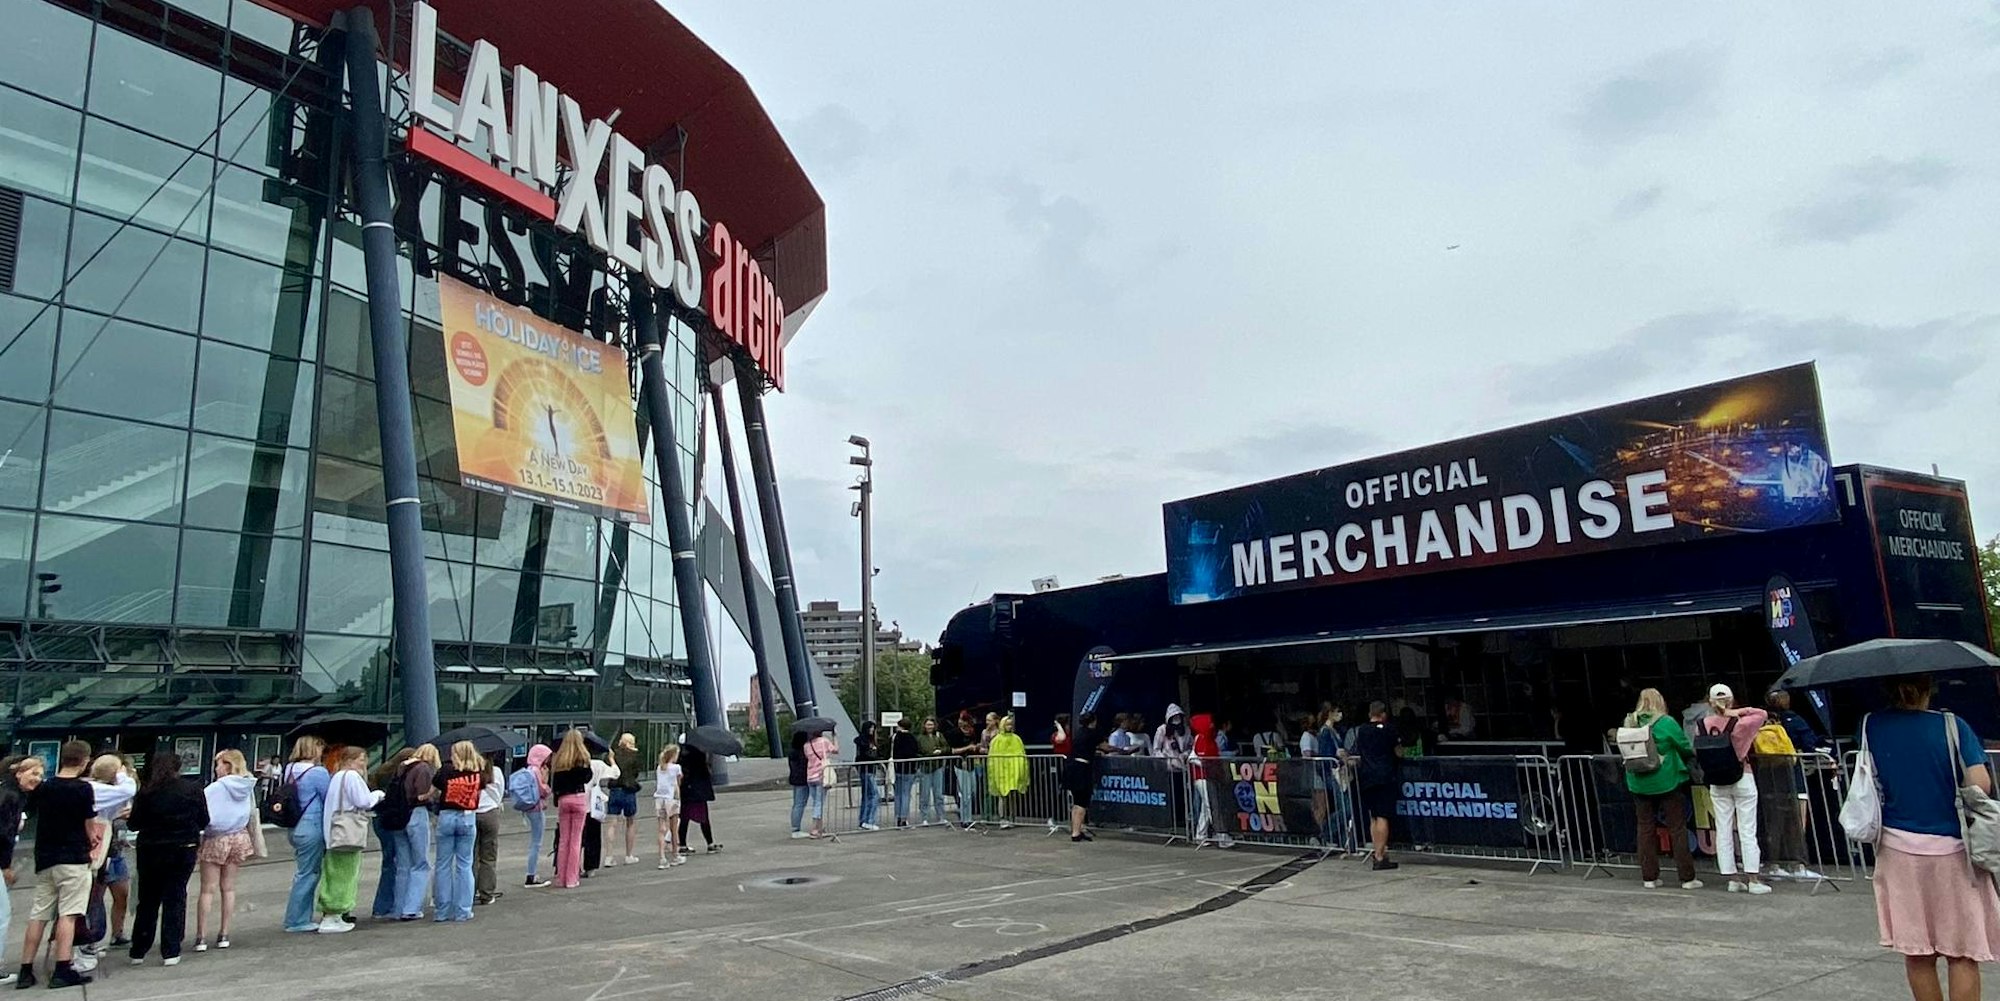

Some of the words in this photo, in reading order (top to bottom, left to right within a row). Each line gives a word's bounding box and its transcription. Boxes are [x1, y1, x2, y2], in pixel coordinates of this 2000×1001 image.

[410, 0, 703, 309] LANXESS
[711, 221, 786, 393] arena
[475, 302, 561, 359] HOLIDAY
[572, 343, 603, 374] ICE
[530, 450, 538, 465] A
[541, 453, 566, 471] NEW
[568, 459, 587, 475] DAY
[519, 468, 603, 501] 13.1.-15.1.2023
[1346, 457, 1488, 509] OFFICIAL
[1231, 469, 1675, 588] MERCHANDISE
[1900, 508, 1946, 532] OFFICIAL
[1888, 535, 1964, 560] MERCHANDISE
[1101, 775, 1149, 790] OFFICIAL
[1229, 762, 1278, 781] LOVE
[1402, 781, 1488, 799] OFFICIAL
[1237, 812, 1288, 832] TOUR
[1396, 800, 1518, 819] ERCHANDISE
